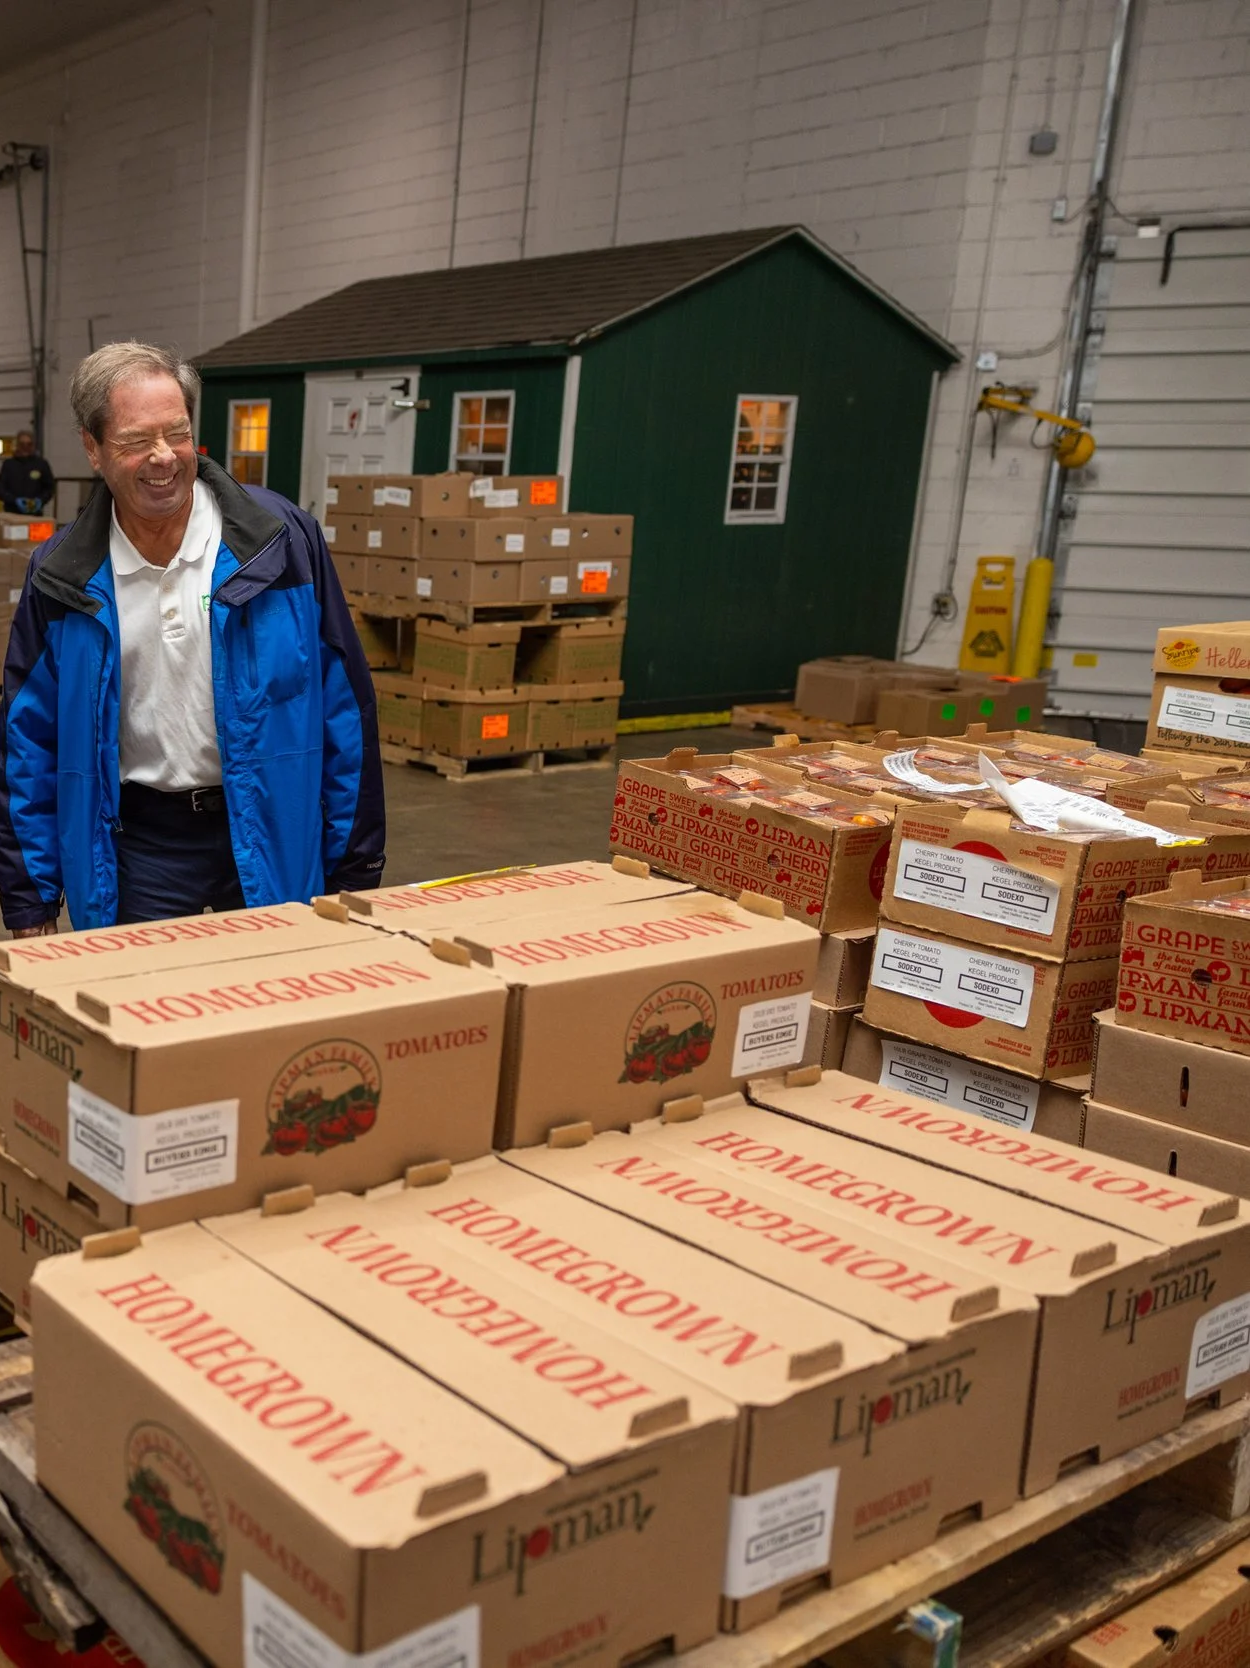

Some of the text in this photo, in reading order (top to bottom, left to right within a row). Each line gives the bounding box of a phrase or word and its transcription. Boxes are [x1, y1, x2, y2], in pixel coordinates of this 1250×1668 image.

[1162, 646, 1201, 660] Sunripe
[623, 778, 697, 807] GRAPE SWEET
[669, 801, 696, 814] TOMATOES
[718, 809, 742, 821] the best
[715, 815, 722, 823] of
[660, 827, 678, 839] family
[738, 833, 758, 846] family
[683, 851, 703, 863] family
[690, 839, 740, 867] GRAPE
[737, 841, 757, 854] farms
[915, 848, 963, 864] CHERRY TOMATO
[771, 848, 828, 878] CHERRY
[914, 858, 962, 874] KEGEL PRODUCE
[1093, 857, 1166, 878] GRAPE SWEET
[798, 875, 824, 889] the best
[919, 871, 944, 884] SODEXO
[992, 865, 1044, 883] CHERRY TOMATO
[372, 869, 603, 912] HOMEGROWN
[714, 867, 768, 895] CHERRY
[770, 886, 803, 903] SWEET
[992, 876, 1043, 893] KEGEL PRODUCE
[998, 890, 1024, 903] SODEXO
[10, 912, 299, 963] HOMEGROWN
[491, 912, 752, 967] HOMEGROWN
[894, 938, 941, 955] CHERRY TOMATO
[1137, 925, 1226, 956] GRAPE
[892, 948, 939, 965] KEGEL PRODUCE
[969, 957, 1020, 975] CHERRY TOMATO
[1152, 960, 1163, 970] of
[1157, 951, 1196, 966] the best
[897, 961, 922, 974] SODEXO
[968, 967, 1018, 985] KEGEL PRODUCE
[116, 961, 434, 1025] HOMEGROWN
[721, 970, 804, 1000] TOMATOES
[974, 981, 999, 995] SODEXO
[1068, 978, 1114, 999] GRAPE
[629, 986, 713, 1042] LIPMAN FAMILY
[771, 1014, 795, 1025] PRODUCE
[385, 1025, 489, 1061] TOMATOES
[748, 1030, 793, 1046] BUYERS EDGE
[899, 1056, 944, 1075] KEGEL PRODUCE
[907, 1048, 927, 1061] GRAPE
[928, 1055, 952, 1067] TOMATO
[271, 1045, 377, 1109] LIPMAN FAMILY
[904, 1069, 928, 1083] SODEXO
[983, 1072, 1004, 1085] GRAPE
[1004, 1079, 1030, 1093] TOMATO
[973, 1080, 1022, 1101] KEGEL PRODUCE
[979, 1094, 1004, 1109] SODEXO
[834, 1091, 1198, 1213] HOMEGROWN
[695, 1131, 1058, 1268] HOMEGROWN
[596, 1155, 959, 1303] HOMEGROWN
[426, 1197, 782, 1368] HOMEGROWN
[1103, 1268, 1209, 1345] Lipman
[306, 1224, 656, 1411] HOMEGROWN
[95, 1273, 427, 1497] HOMEGROWN
[1118, 1366, 1181, 1409] HOMEGROWN
[830, 1368, 962, 1458] Lipman
[854, 1476, 934, 1527] HOMEGROWN
[471, 1490, 645, 1597] Lipman
[224, 1496, 346, 1621] TOMATOES
